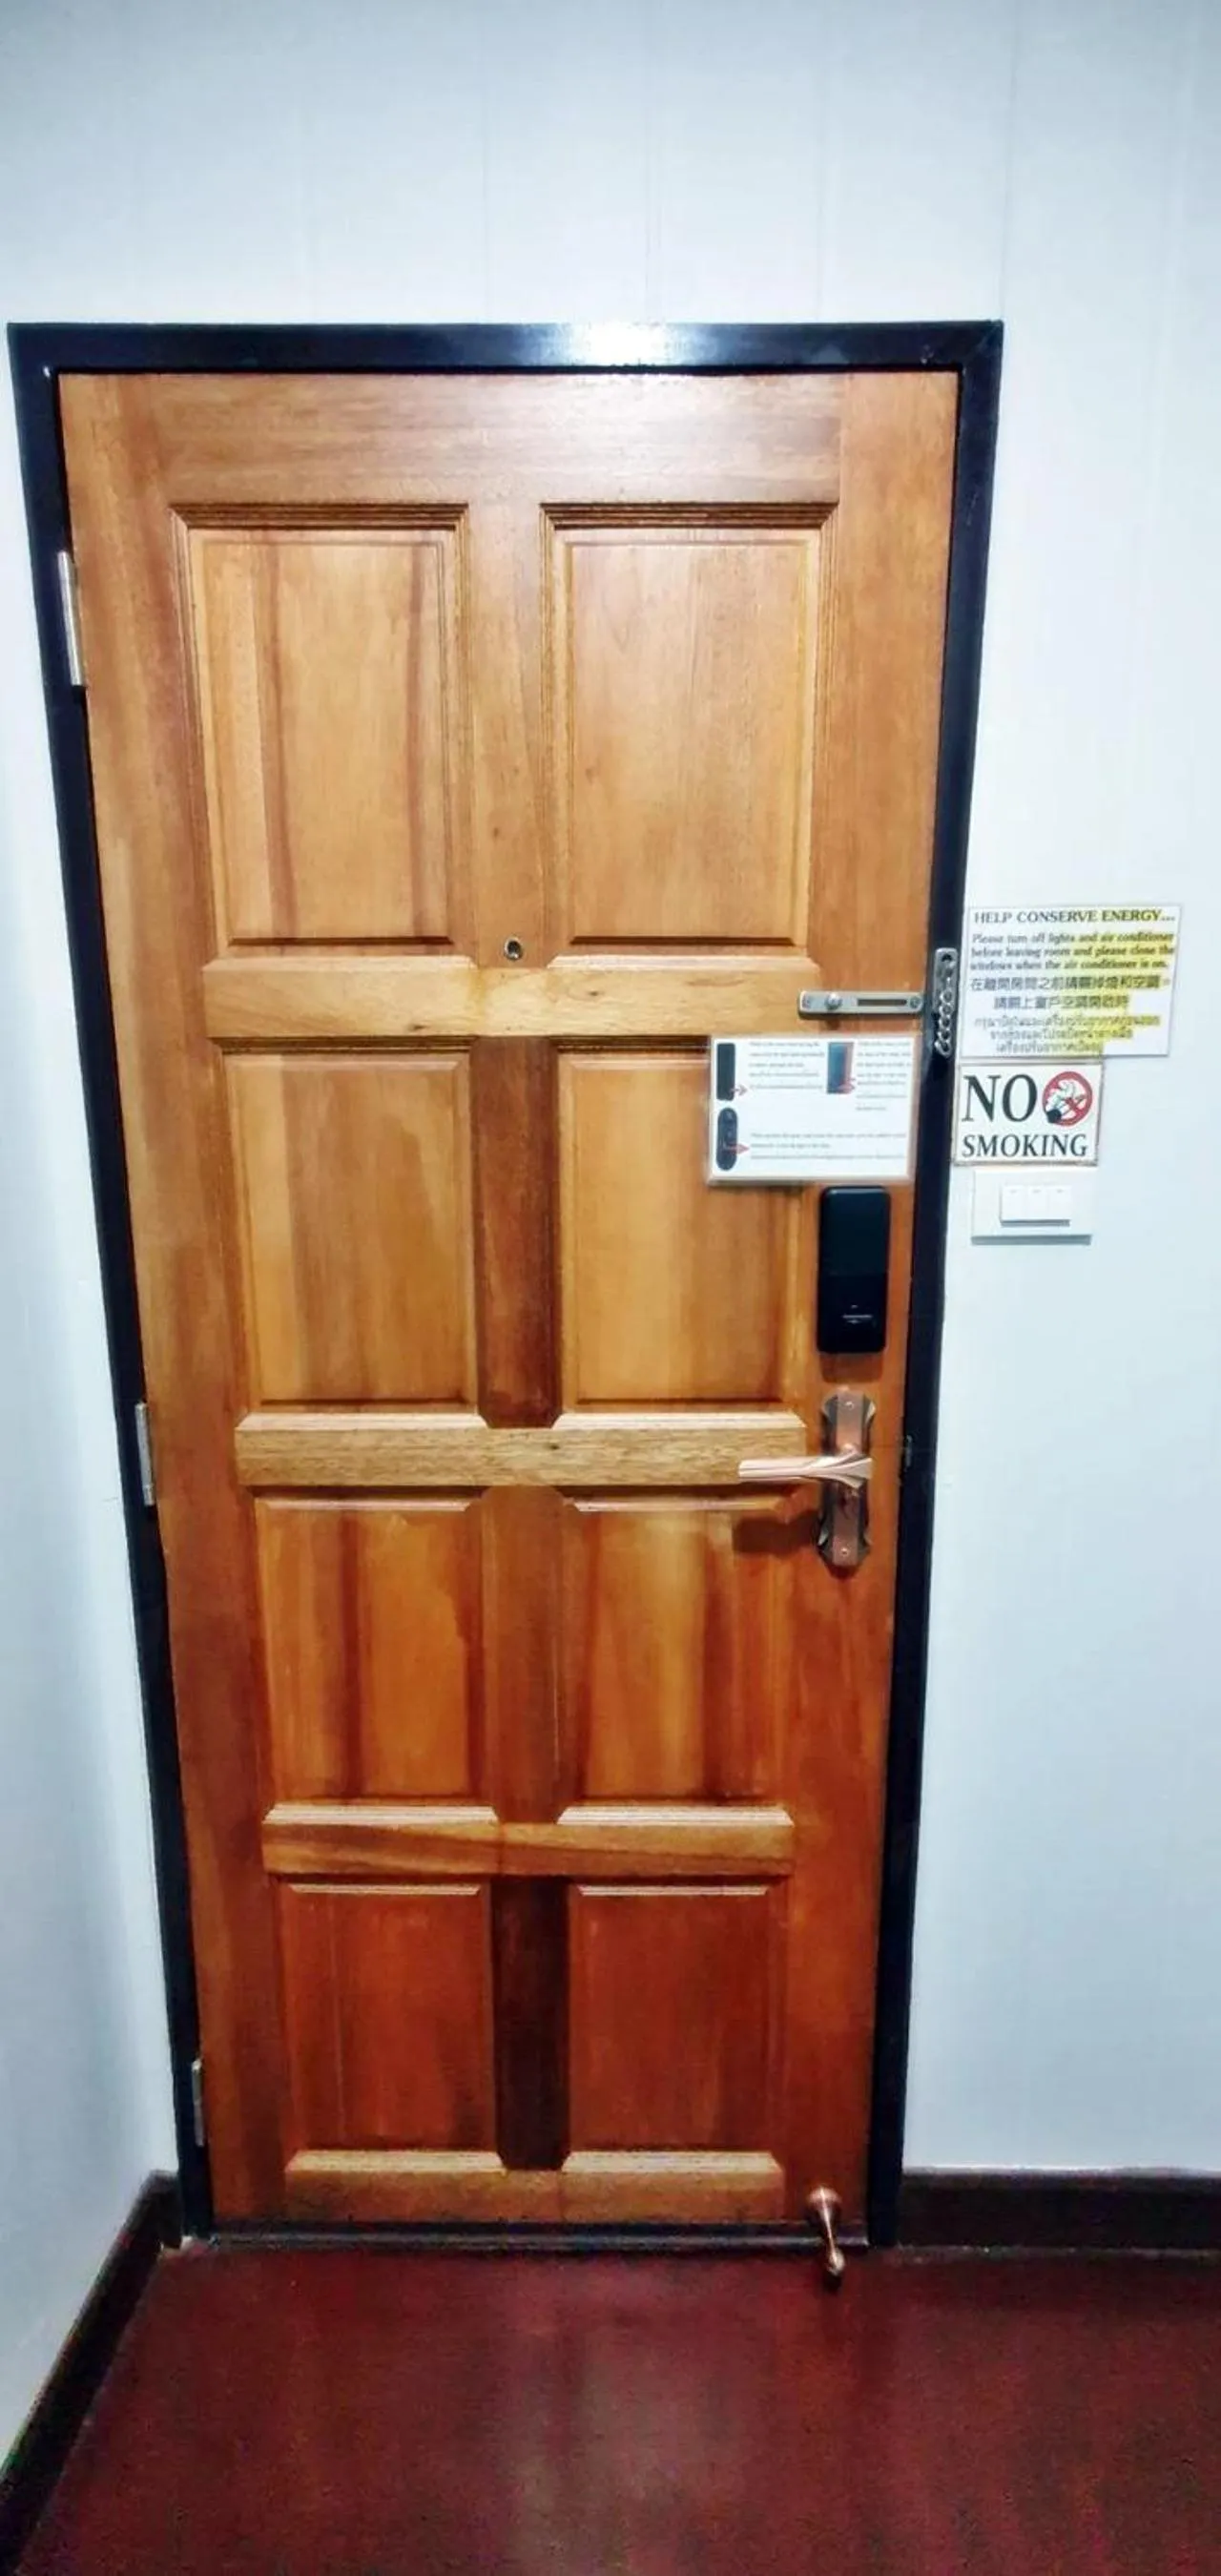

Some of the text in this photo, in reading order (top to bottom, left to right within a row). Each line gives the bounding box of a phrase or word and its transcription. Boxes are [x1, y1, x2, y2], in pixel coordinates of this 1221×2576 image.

[974, 911, 1011, 924] HELP
[1017, 910, 1098, 923] CONSERVE
[972, 931, 1174, 945] Please turn off lights and air conditioner
[971, 945, 1174, 958] before leaving room and please close the
[970, 961, 1012, 970] windows
[1016, 961, 1042, 969] when
[1045, 960, 1060, 969] the
[1064, 960, 1078, 969] air
[1081, 959, 1136, 969] conditioner
[1141, 959, 1149, 968] is
[962, 1073, 1038, 1122] NO
[962, 1133, 1088, 1158] SMOKING
